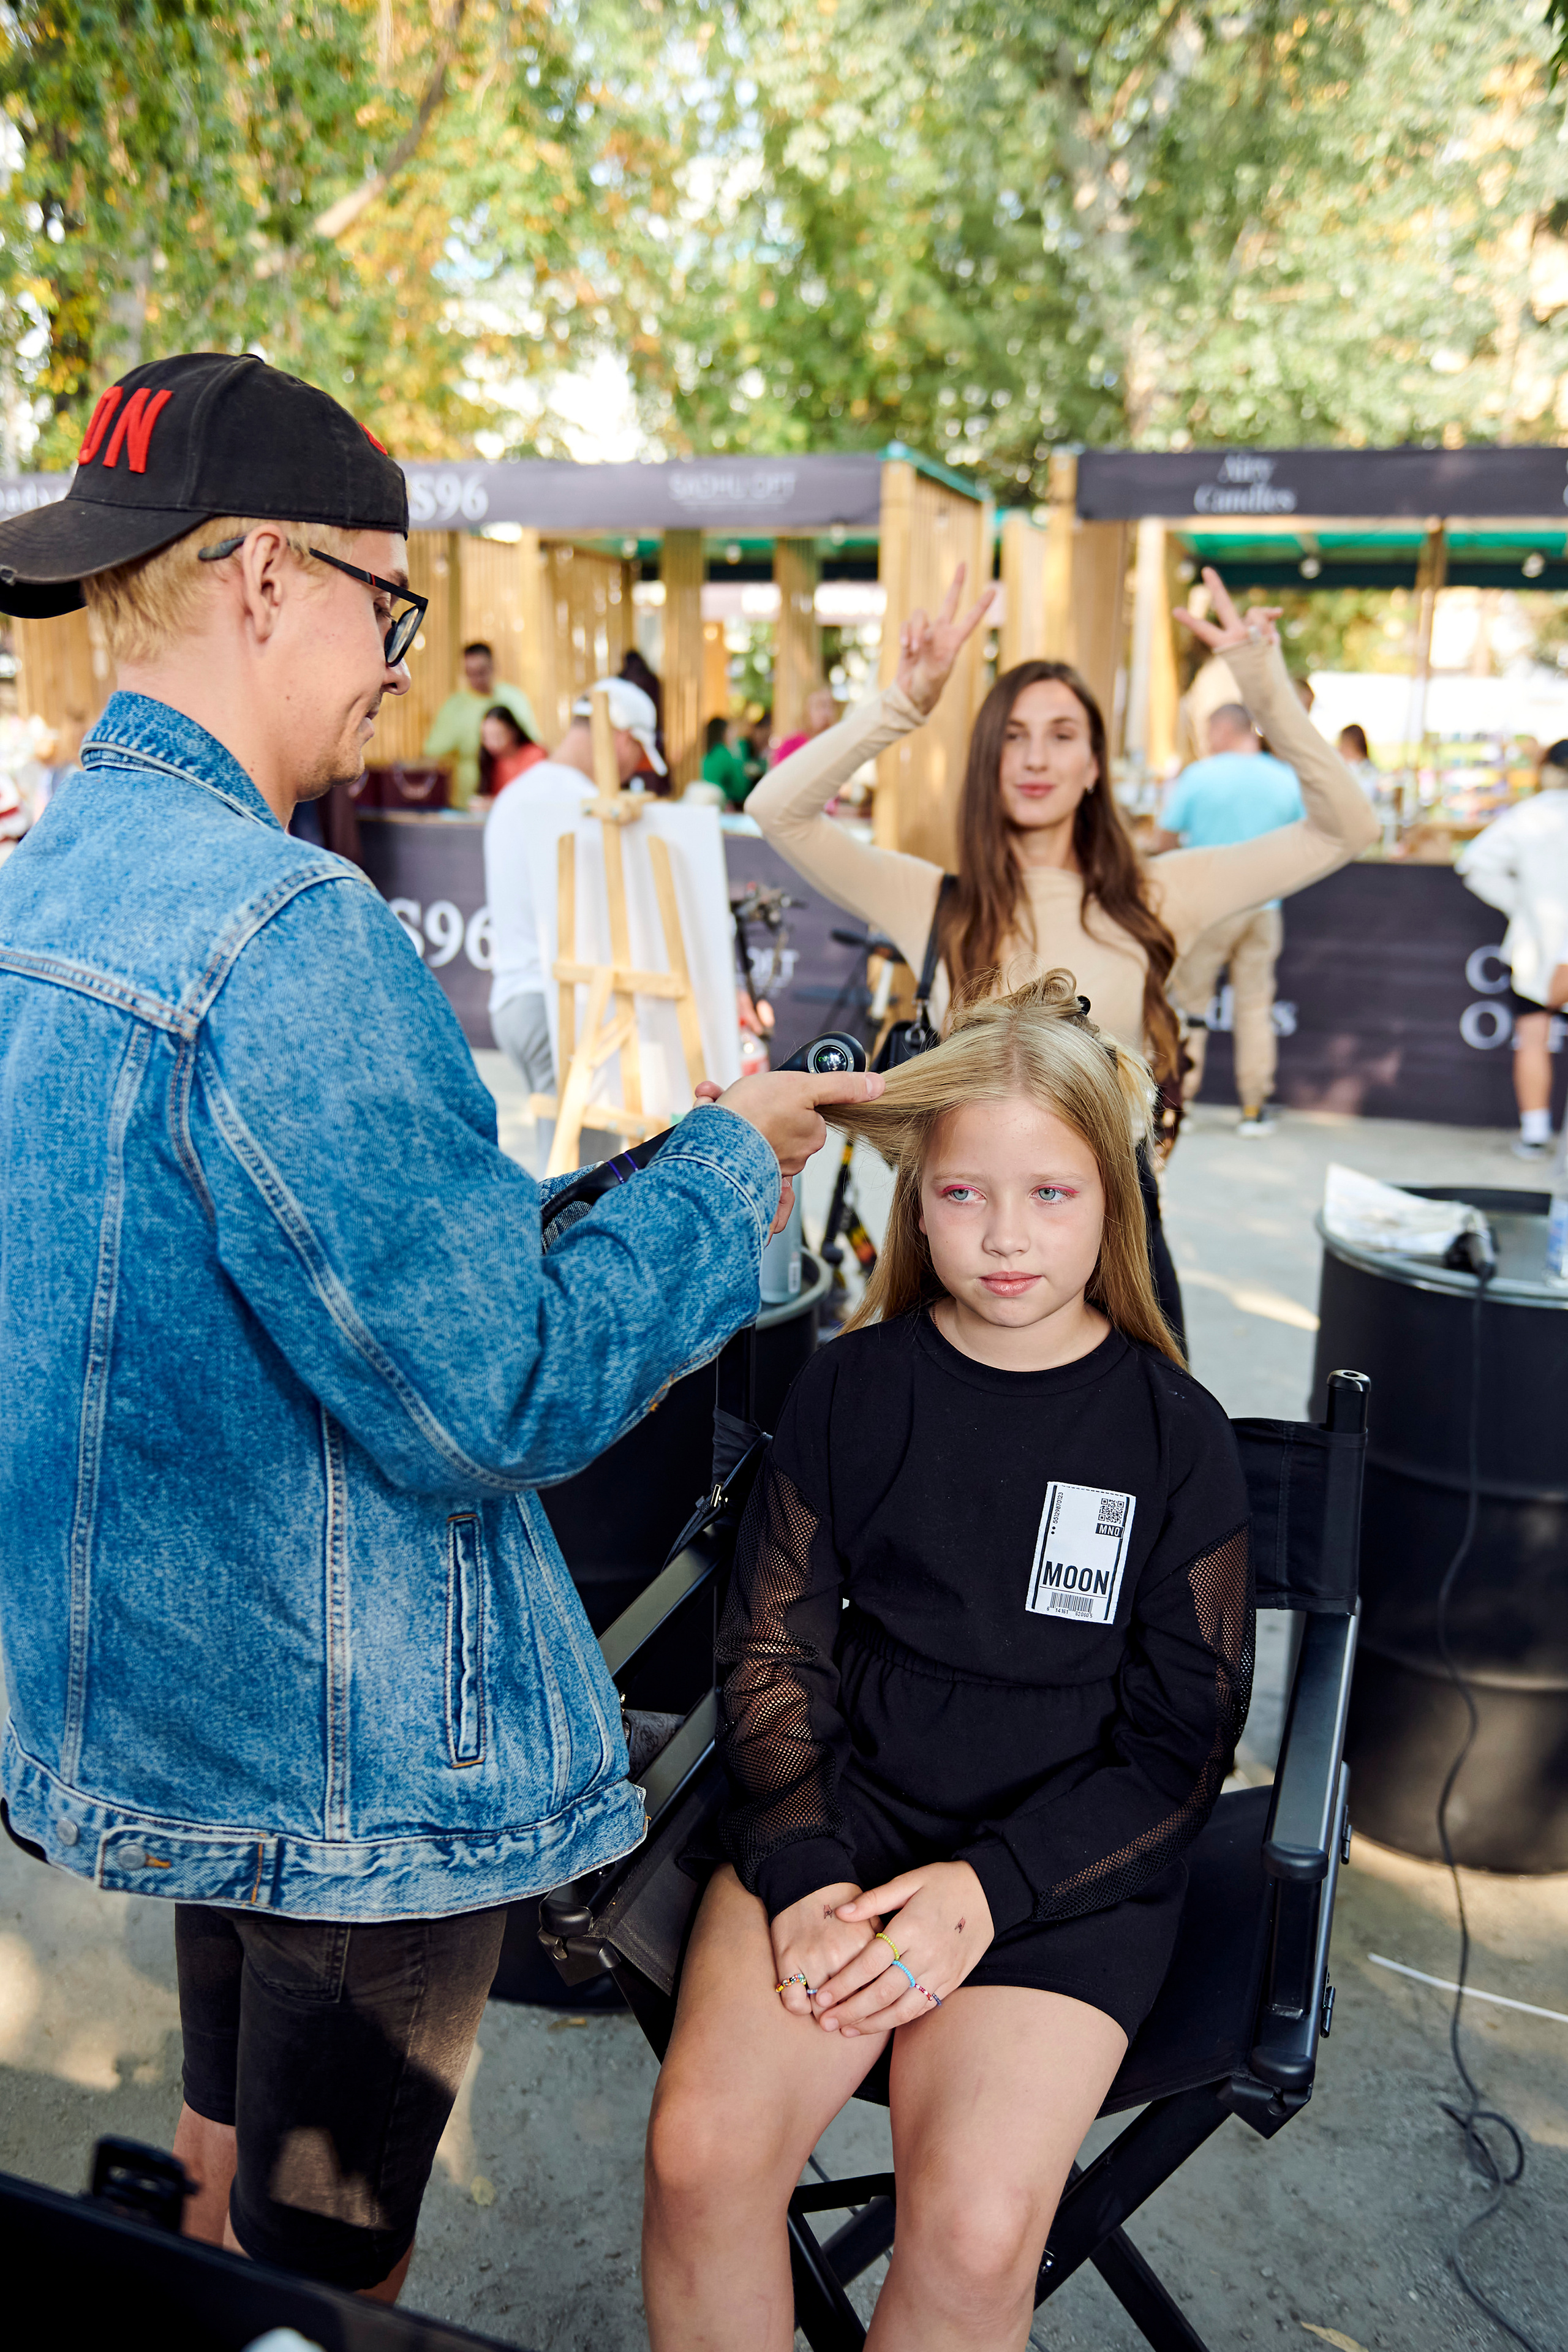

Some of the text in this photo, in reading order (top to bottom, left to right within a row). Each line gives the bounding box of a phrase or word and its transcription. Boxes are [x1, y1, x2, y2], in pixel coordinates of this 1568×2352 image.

[1194, 481, 1297, 514] Candles
[389, 897, 497, 971] S96
[1099, 1524, 1120, 1536] MNO
[1042, 1561, 1110, 1595] MOON
